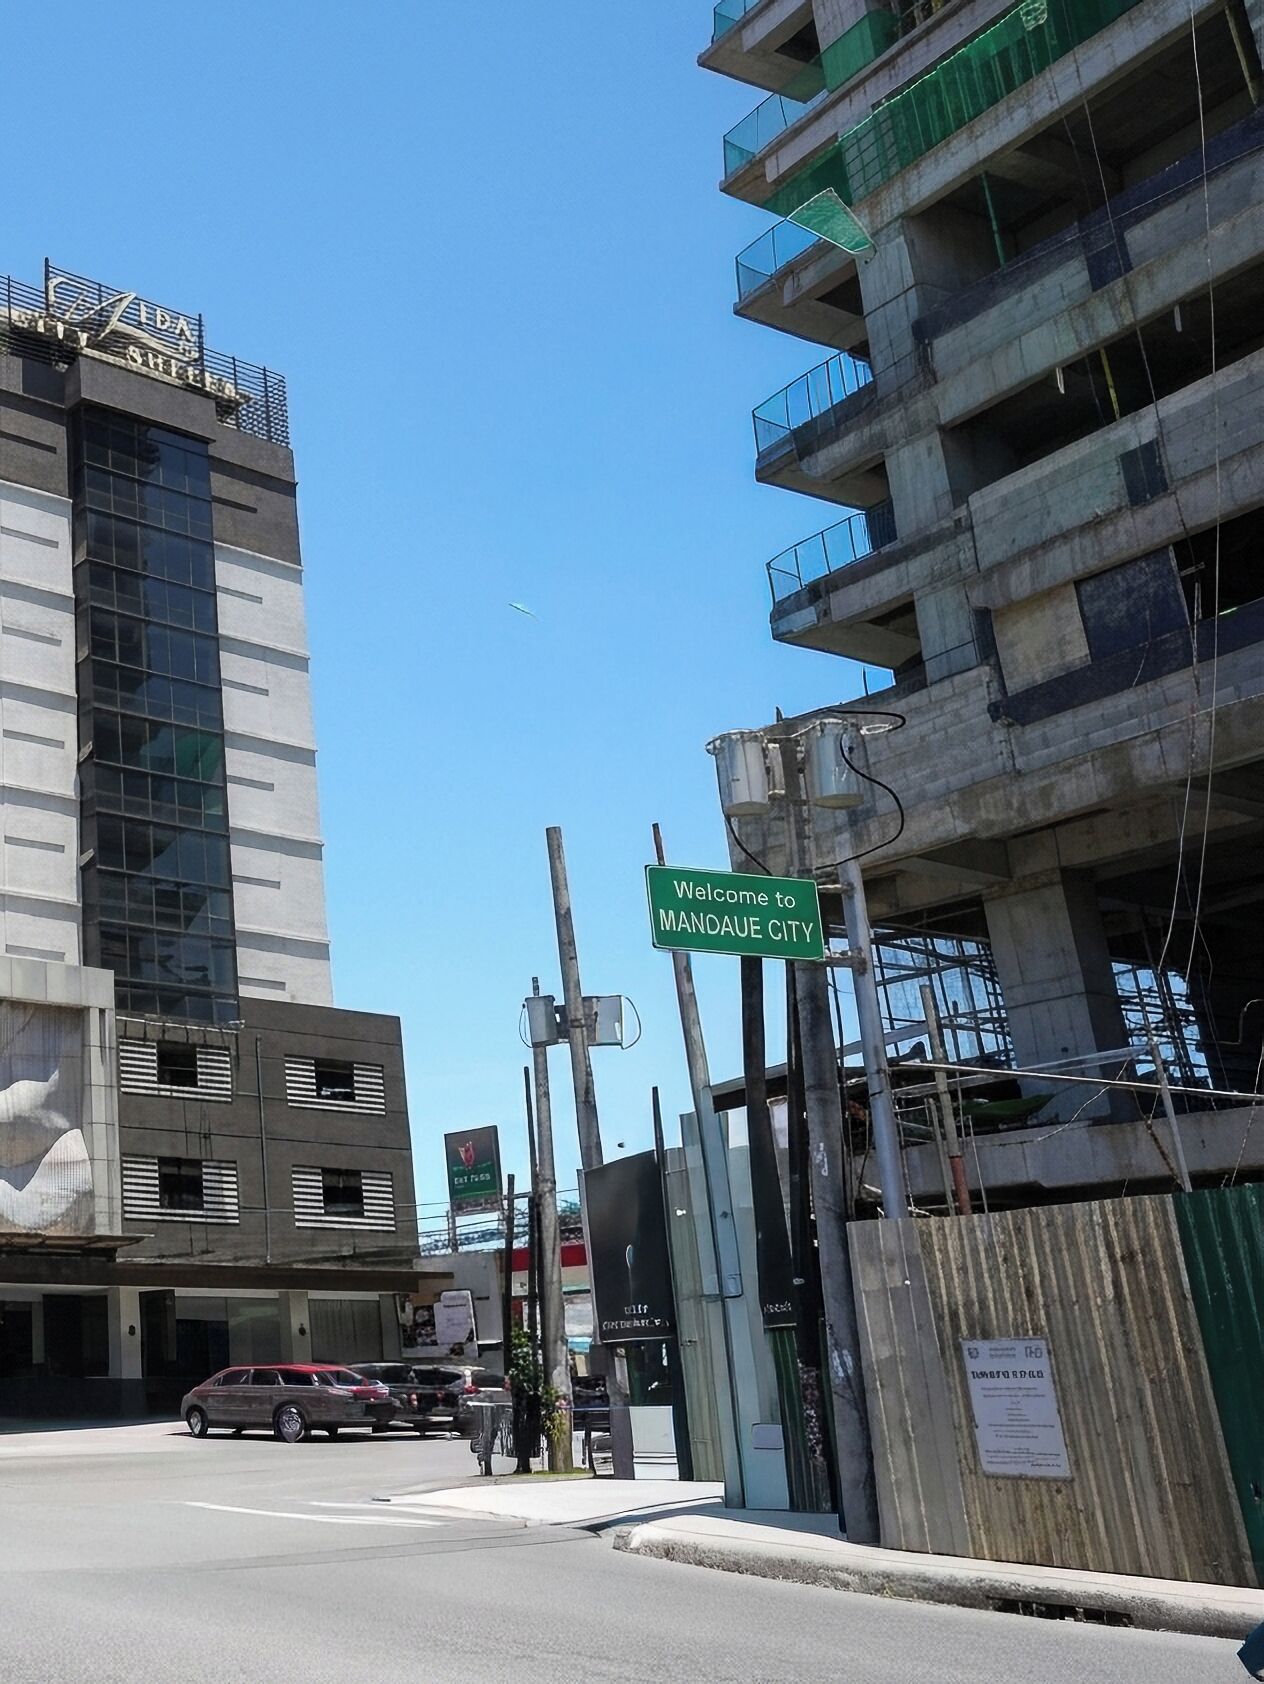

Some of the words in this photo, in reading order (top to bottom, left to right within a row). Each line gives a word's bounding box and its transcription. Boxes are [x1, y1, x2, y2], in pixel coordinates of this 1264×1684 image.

[673, 880, 769, 907] Welcome
[775, 891, 796, 909] to
[659, 908, 763, 939] MANDAUE
[768, 919, 814, 943] CITY
